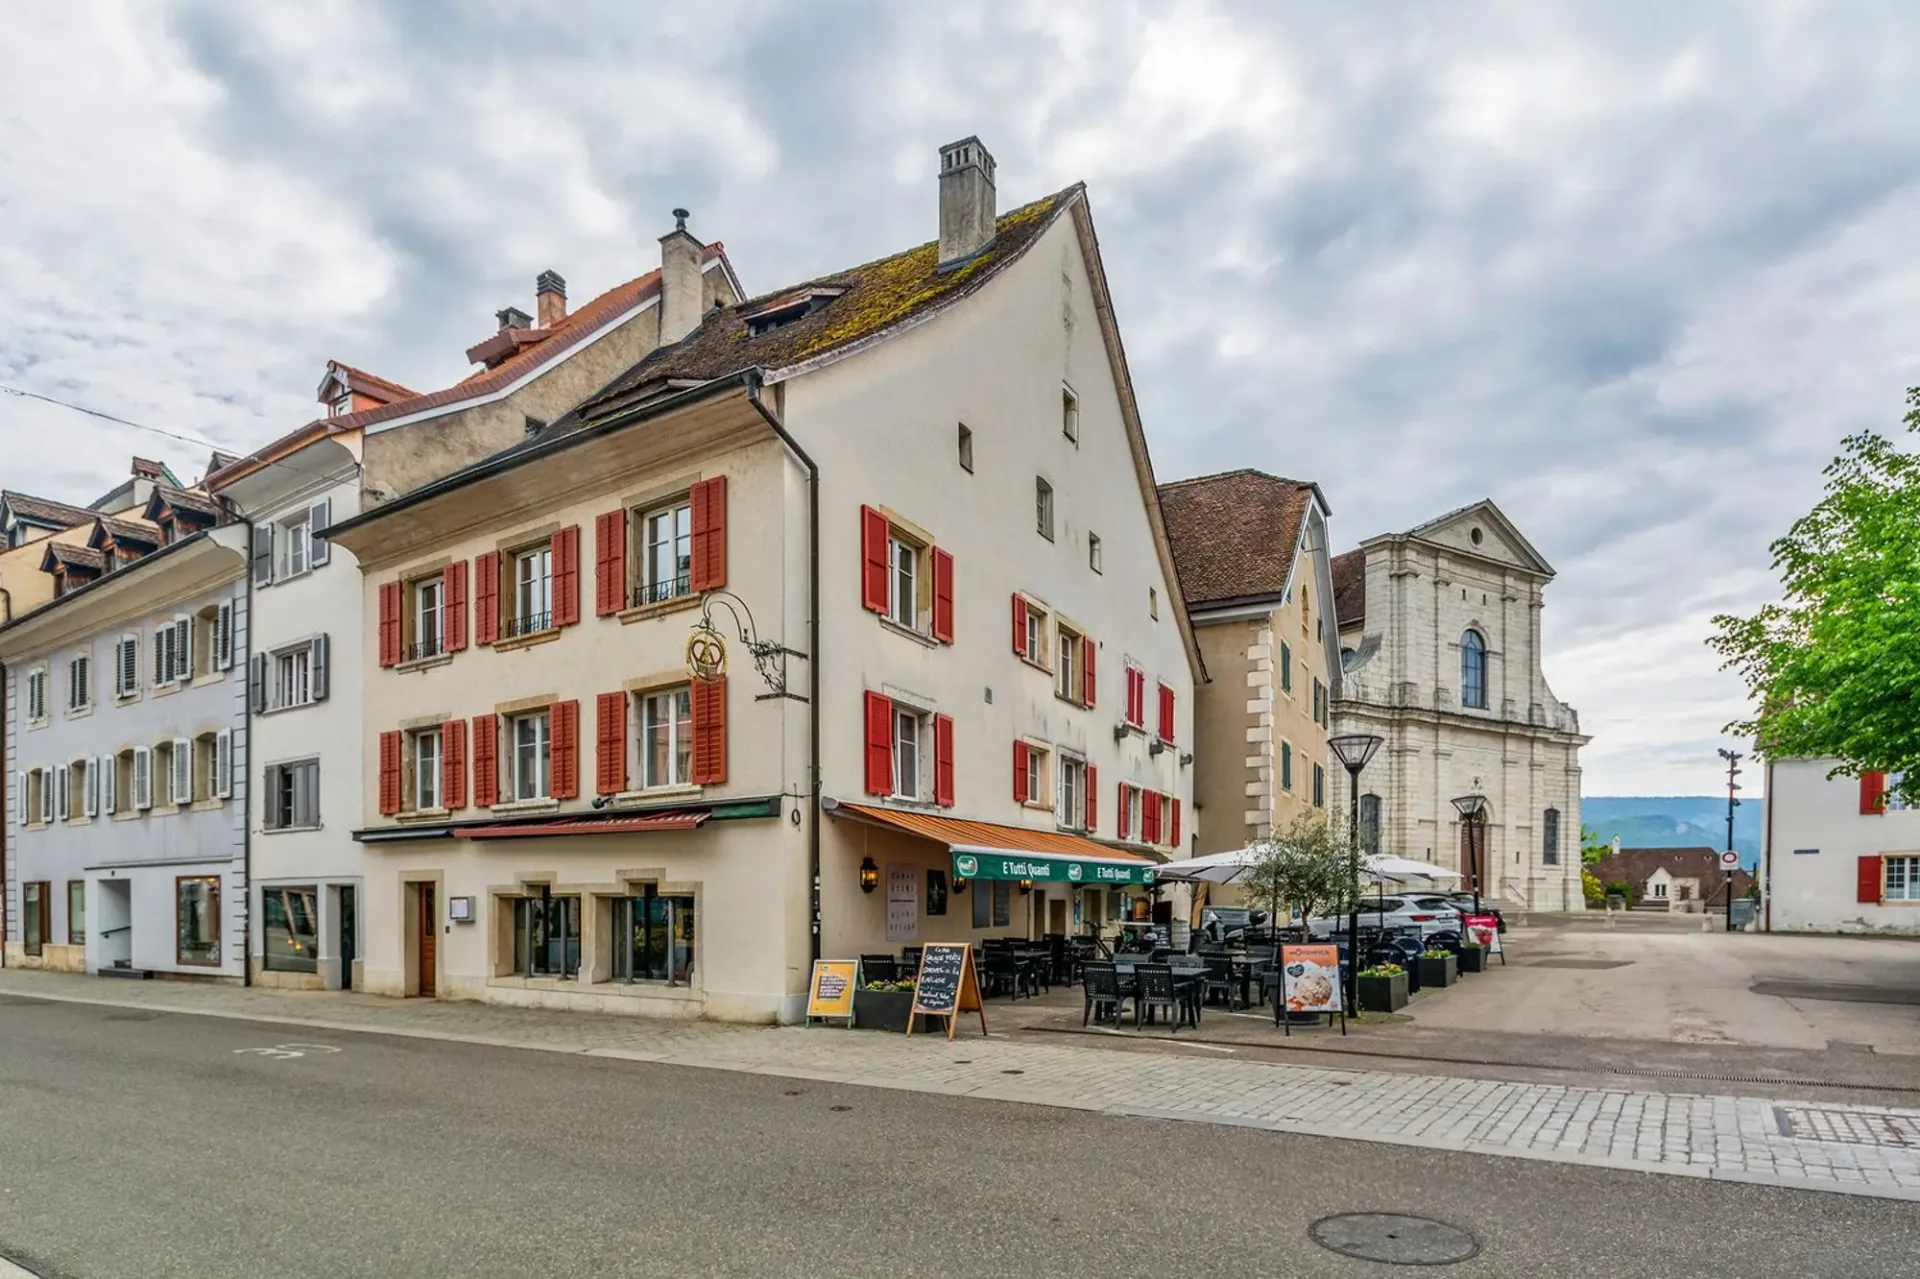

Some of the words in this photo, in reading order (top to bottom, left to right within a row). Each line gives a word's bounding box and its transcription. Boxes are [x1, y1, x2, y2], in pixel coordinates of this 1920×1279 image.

[1002, 861, 1008, 875] E
[1009, 861, 1027, 876] Tutti
[1027, 862, 1050, 878] Quanti
[1097, 867, 1102, 878] E
